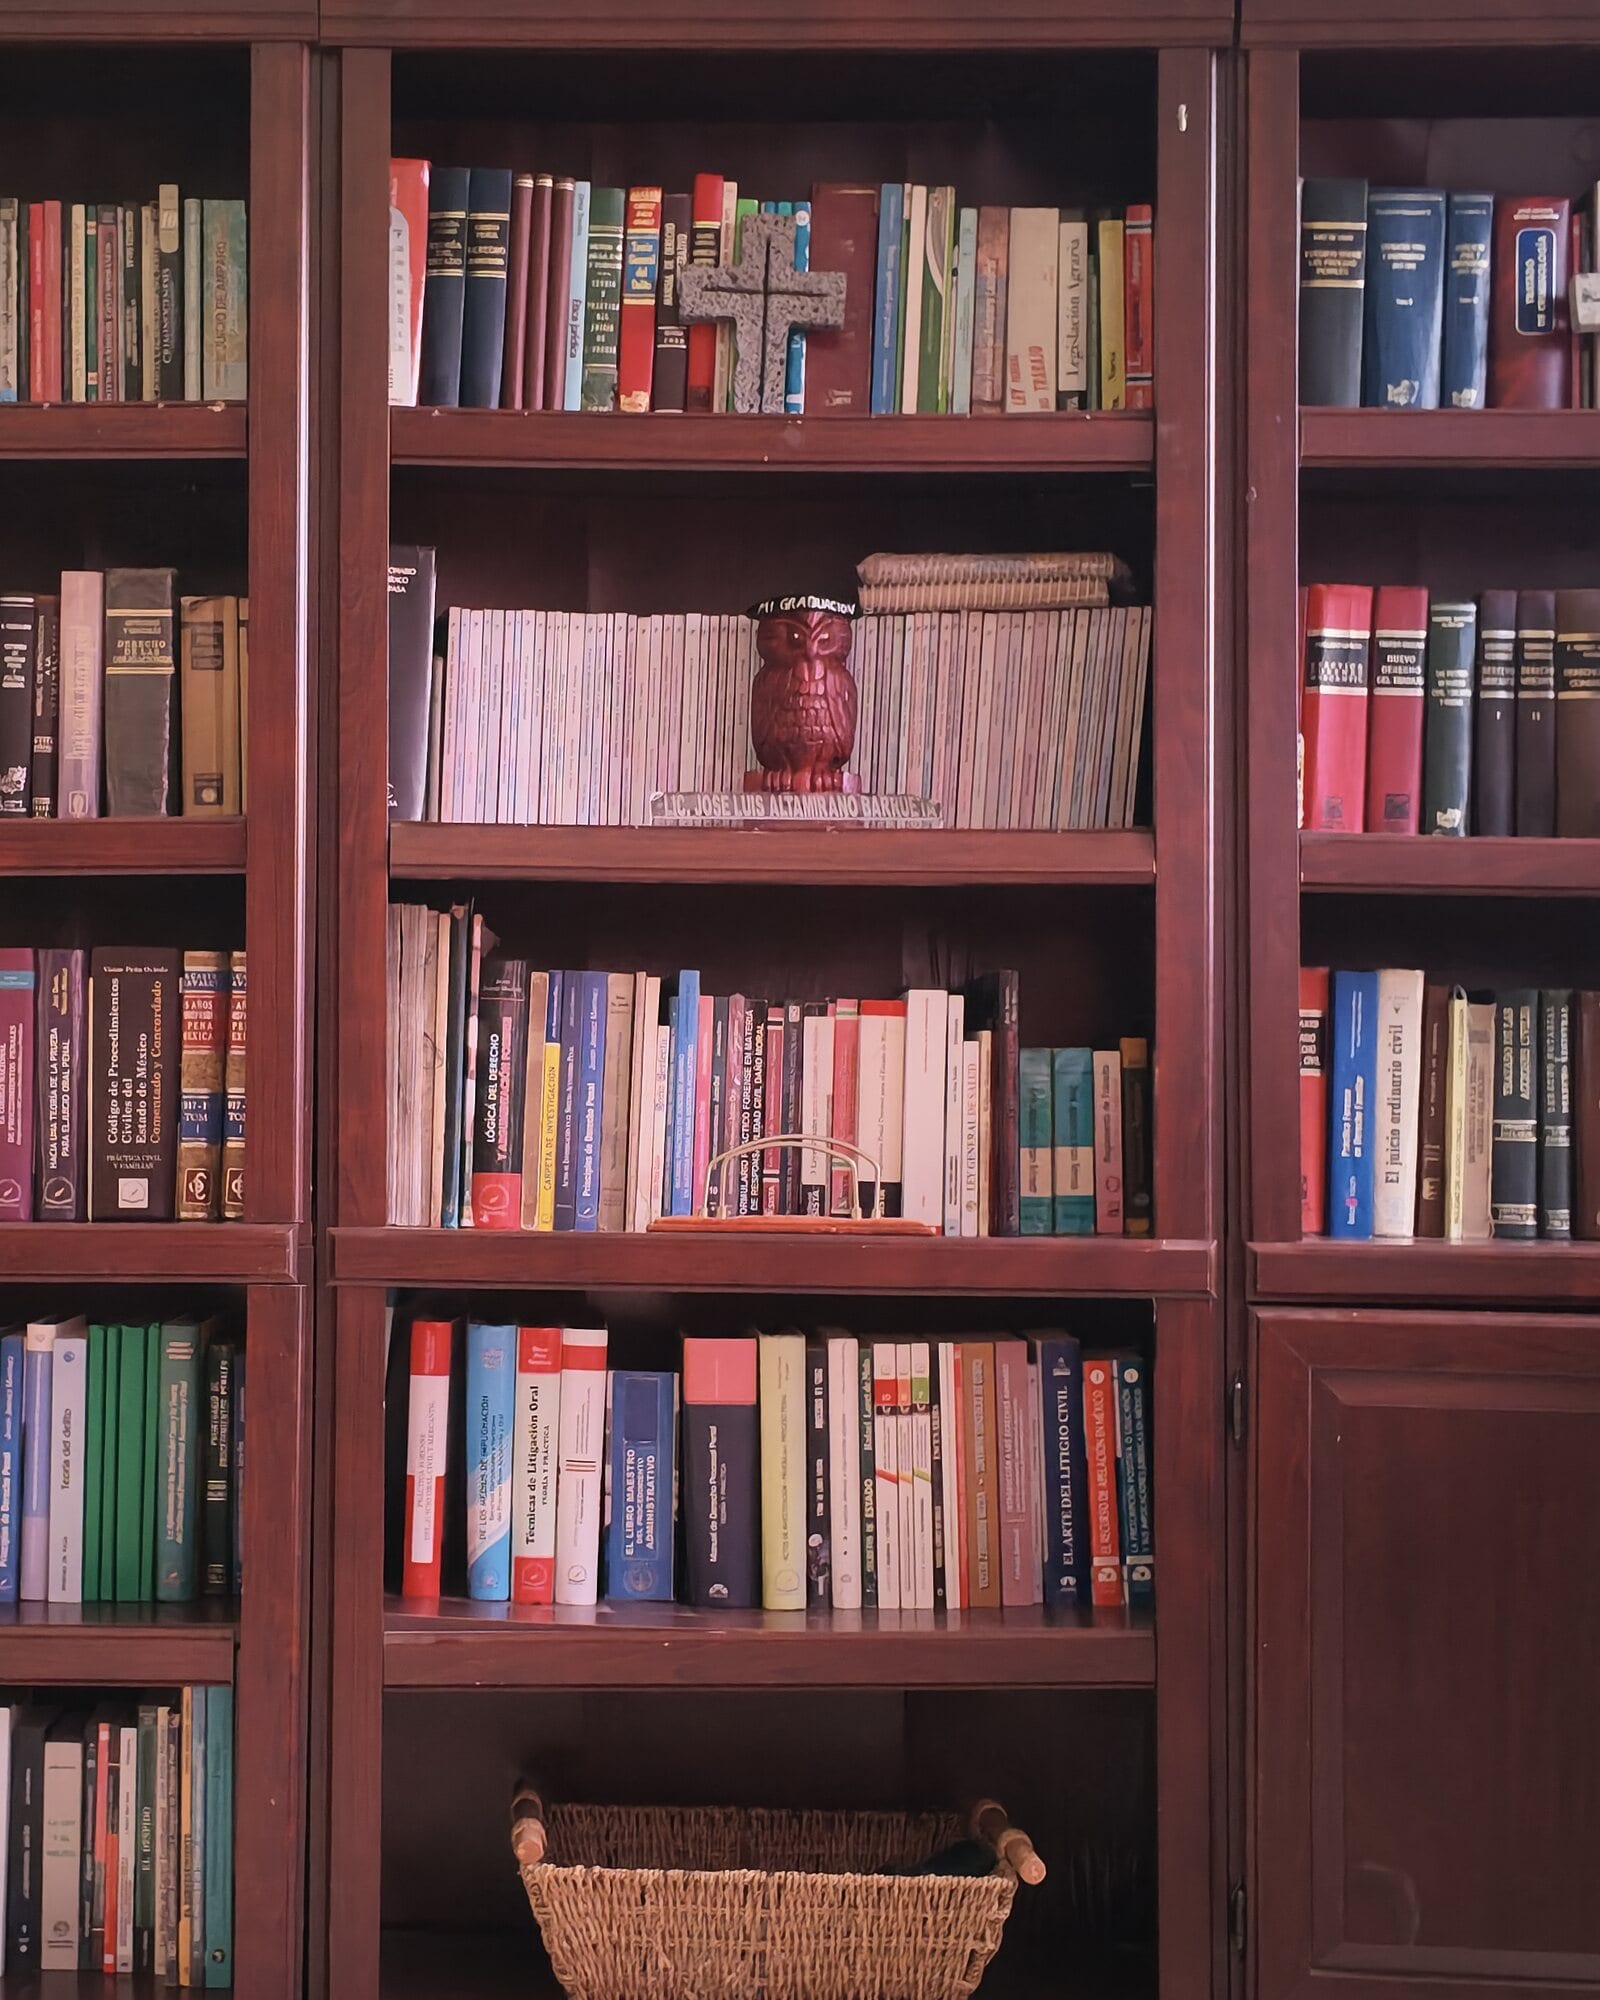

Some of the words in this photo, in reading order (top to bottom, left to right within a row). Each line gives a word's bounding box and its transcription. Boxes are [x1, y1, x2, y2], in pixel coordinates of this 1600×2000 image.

[215, 241, 227, 291] AMPARO
[215, 293, 227, 310] DE
[215, 312, 227, 350] JUICIO
[1028, 345, 1049, 391] TRABAJO
[1010, 388, 1026, 406] LEY
[117, 640, 166, 648] DERECHO
[664, 797, 691, 816] LIC.
[695, 796, 731, 816] JOSE
[734, 796, 765, 817] LUIS
[770, 796, 858, 817] ALTAMIRANO
[107, 978, 120, 1077] Procedimientos
[150, 980, 162, 1058] Concordado
[743, 1009, 753, 1051] MATERIA
[1388, 1024, 1403, 1054] civil
[50, 1062, 58, 1074] LA
[135, 1032, 148, 1078] México
[489, 1033, 499, 1080] DERECHO
[743, 1052, 752, 1065] EN
[753, 1057, 762, 1084] DAÑO
[50, 1075, 58, 1088] DE
[107, 1079, 119, 1097] de
[122, 1078, 133, 1102] del
[136, 1081, 147, 1098] de
[488, 1083, 498, 1100] DEL
[742, 1067, 751, 1110] FORENSE
[1387, 1059, 1402, 1124] ordinario
[49, 1089, 58, 1121] TEORÍA
[150, 1071, 162, 1144] Comentado
[967, 1101, 977, 1116] DE
[107, 1099, 119, 1144] Código
[121, 1102, 133, 1144] Civiles
[135, 1100, 147, 1144] Estado
[485, 1103, 497, 1143] LÓGICA
[7, 1132, 16, 1143] DE
[61, 1135, 70, 1157] PARA
[545, 1136, 554, 1147] DE
[967, 1120, 976, 1169] GENERAL
[1385, 1128, 1403, 1166] juicio
[49, 1142, 58, 1169] HACIA
[543, 1149, 554, 1191] CARPETA
[739, 1159, 749, 1214] ORMULARIO
[966, 1171, 976, 1192] LEY
[1384, 1171, 1400, 1184] El
[750, 1197, 759, 1211] DE
[529, 1385, 539, 1411] Oral
[1058, 1385, 1069, 1423] CIVIL
[527, 1414, 539, 1474] Litigación
[1058, 1426, 1070, 1478] LITIGIO
[526, 1476, 537, 1491] de
[625, 1449, 635, 1502] MAESTRO
[646, 1455, 655, 1550] ADMINISTRATIVO
[863, 1478, 874, 1518] ESTADO
[1061, 1480, 1072, 1508] DEL
[479, 1509, 487, 1526] LOS
[525, 1494, 537, 1545] Técnicas
[625, 1504, 635, 1538] LIBRO
[1062, 1511, 1073, 1546] ARTE
[479, 1530, 486, 1539] DE
[625, 1541, 634, 1556] EL
[1062, 1548, 1073, 1565] EL
[141, 1857, 151, 1871] EL
